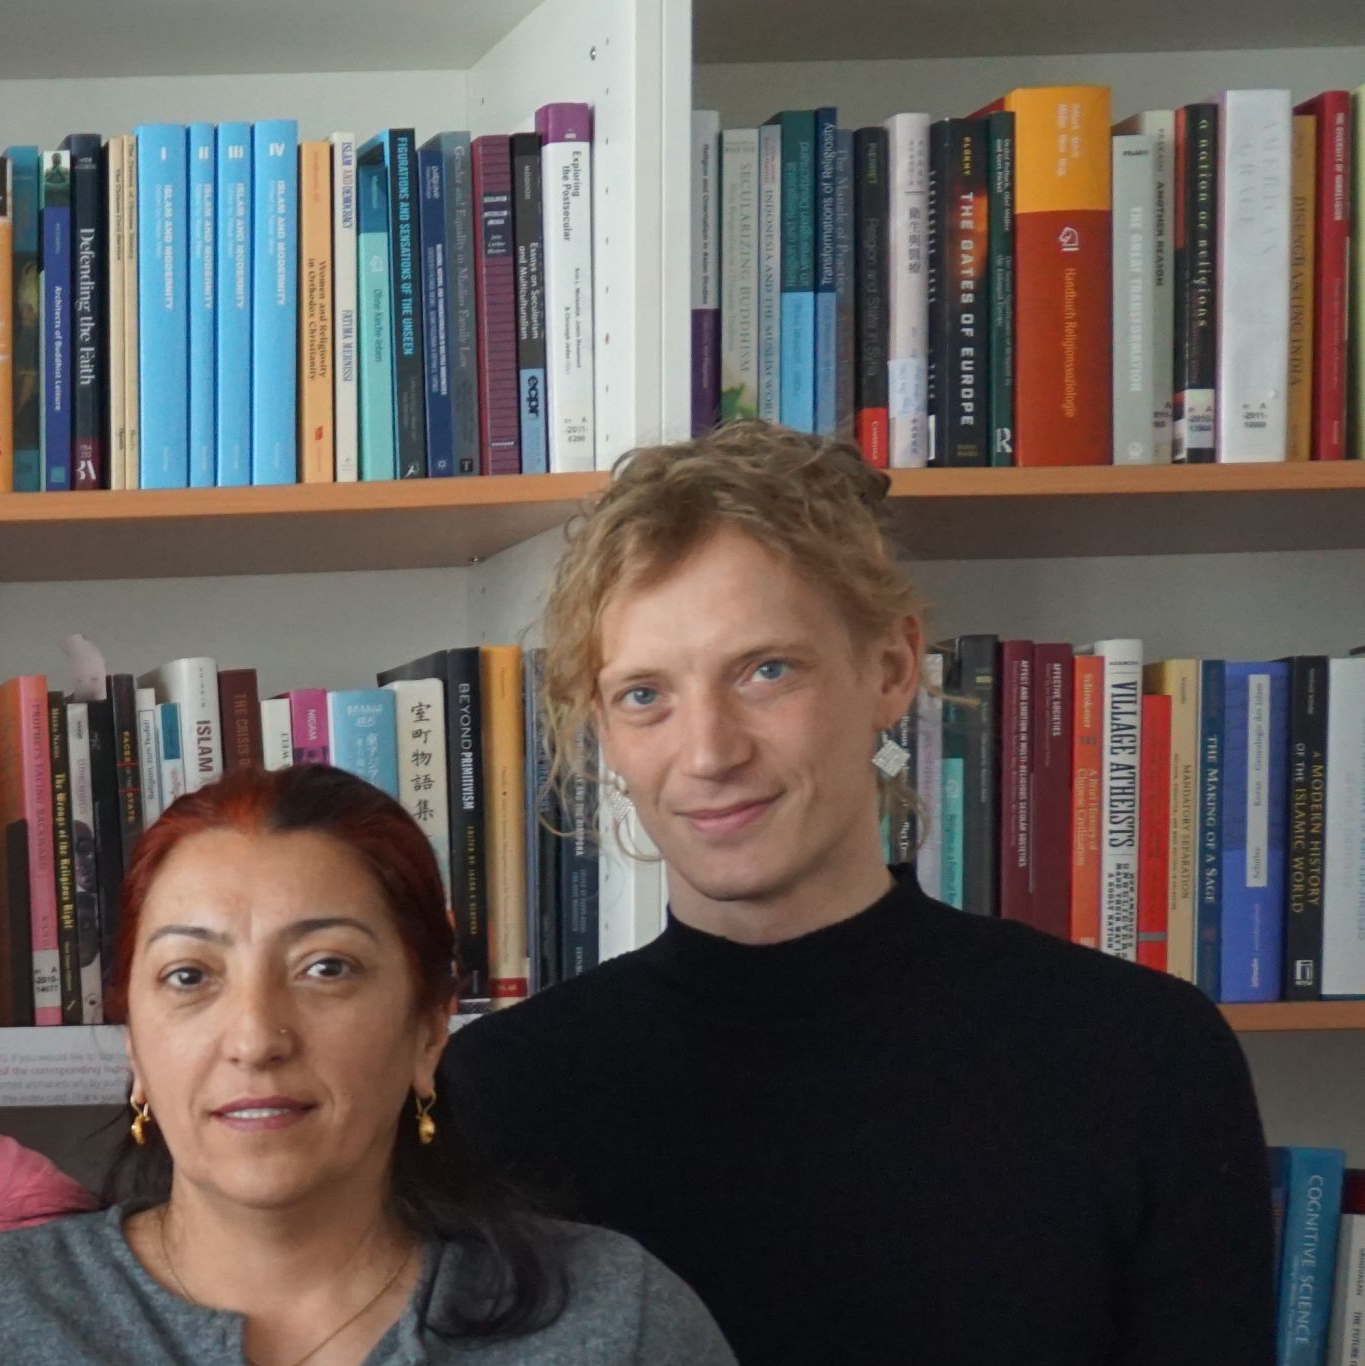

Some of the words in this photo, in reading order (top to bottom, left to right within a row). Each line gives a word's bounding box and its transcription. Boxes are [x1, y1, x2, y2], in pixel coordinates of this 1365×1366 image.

[268, 142, 285, 157] IV
[396, 136, 409, 198] FIGURATIONS
[561, 165, 571, 181] the
[570, 151, 582, 197] Exploring
[820, 121, 835, 178] Religiosity
[276, 180, 285, 213] ISLAM
[398, 201, 409, 220] AND
[561, 183, 572, 241] Postsecular
[821, 182, 833, 193] of
[959, 191, 973, 230] THE
[276, 216, 285, 238] AND
[398, 222, 411, 280] SENSATIONS
[820, 197, 833, 284] Transformations
[73, 227, 95, 312] Defending
[276, 241, 285, 305] MODERNITY
[400, 282, 411, 296] OF
[959, 239, 973, 303] GATES
[79, 315, 95, 341] the
[400, 298, 412, 315] THE
[960, 313, 974, 337] OF
[401, 317, 413, 355] UNSEEN
[79, 346, 95, 385] Faith
[960, 347, 974, 426] EUROPE
[525, 374, 540, 418] ecpr
[307, 709, 316, 740] NIGAM
[458, 682, 471, 750] BEYOND
[1110, 680, 1138, 757] VILLAGE
[195, 719, 213, 772] ISLAM
[409, 699, 436, 823] 室町物語集
[1206, 734, 1217, 762] THE
[1296, 742, 1305, 757] OF
[460, 751, 474, 809] PRIMITIVISM
[1296, 762, 1304, 782] THE
[1108, 761, 1136, 848] ATHEISTS
[1205, 768, 1218, 826] MAKING
[1292, 788, 1306, 848] ISLAMIC
[1309, 764, 1323, 834] MODERN
[1205, 831, 1217, 850] OF
[1205, 853, 1217, 863] A
[1204, 867, 1217, 903] SAGE
[1291, 856, 1305, 913] WORLD
[1307, 840, 1321, 905] HISTORY
[1300, 1174, 1323, 1269] COGNITIVE
[1293, 1274, 1314, 1344] SCIENCE
